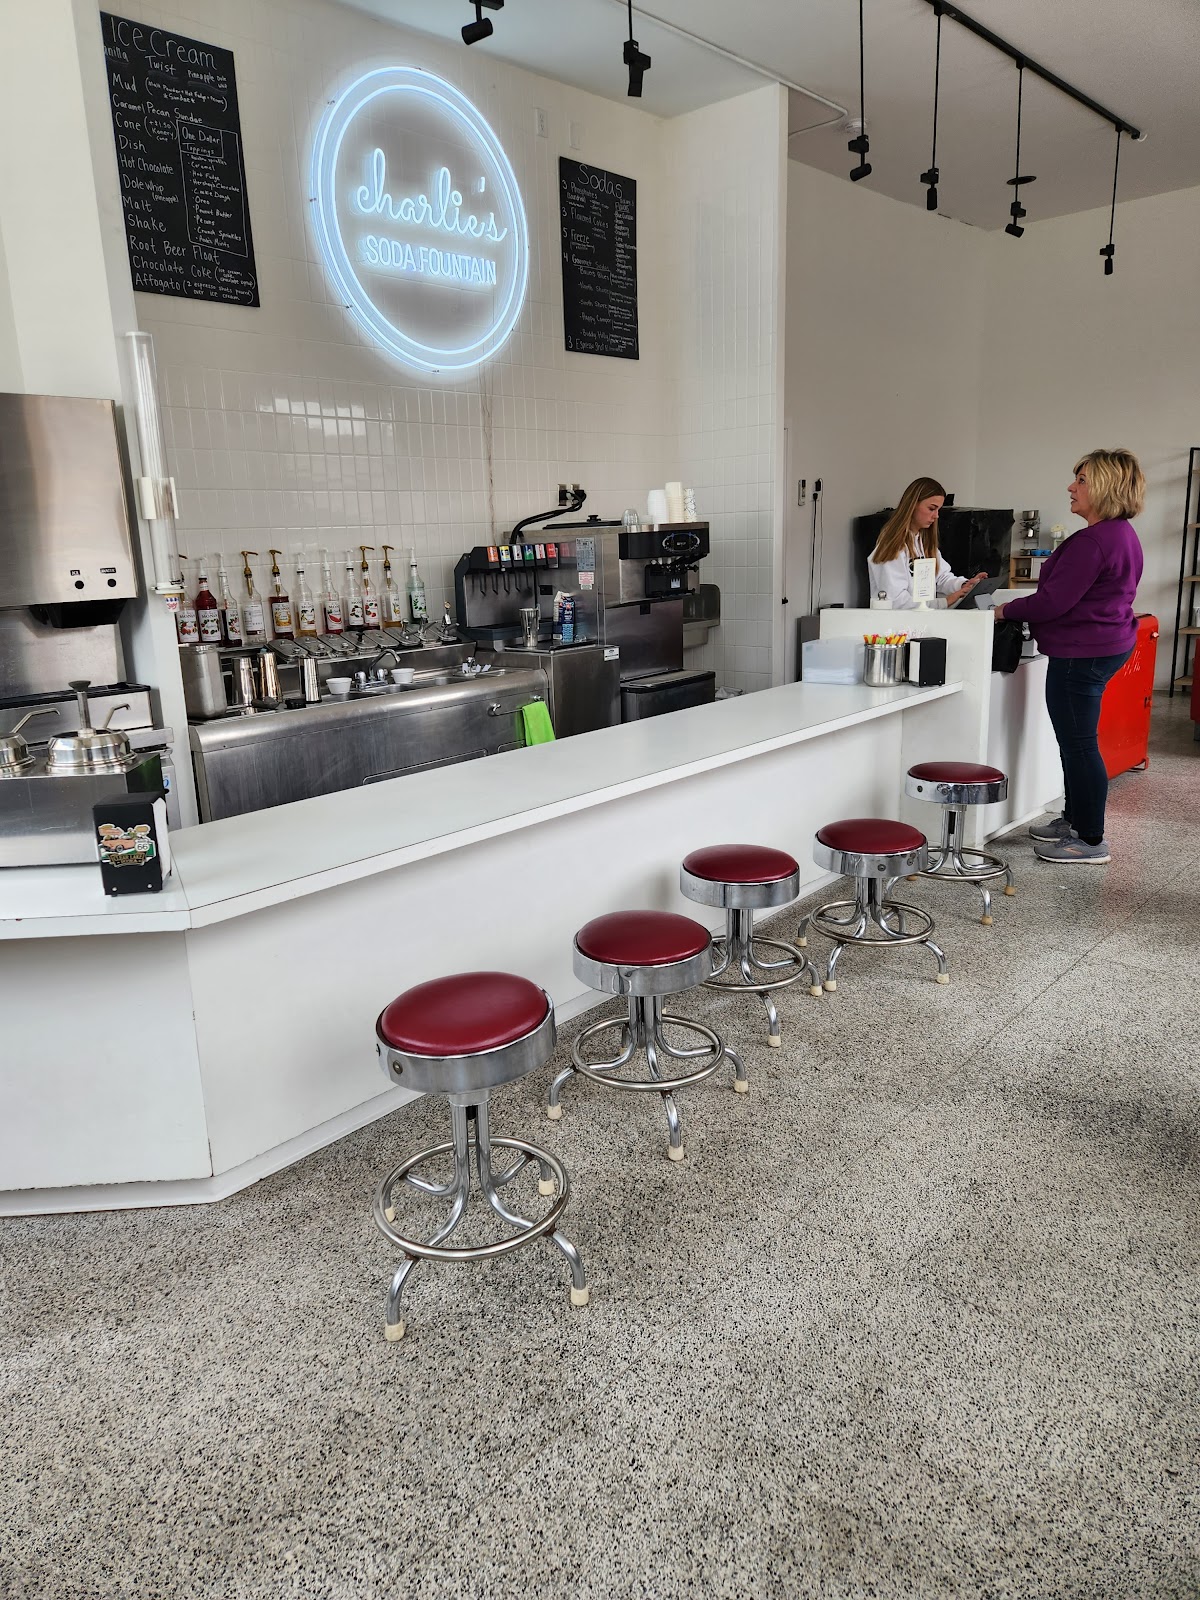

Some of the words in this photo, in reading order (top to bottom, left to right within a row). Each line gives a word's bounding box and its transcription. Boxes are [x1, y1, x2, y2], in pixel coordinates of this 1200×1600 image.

[104, 46, 129, 62] anilla
[150, 30, 217, 70] Cream
[145, 55, 176, 75] Twist
[113, 73, 137, 93] Mud
[113, 93, 145, 114] Caramel
[147, 101, 170, 118] Pecan
[174, 107, 203, 124] Sundae
[116, 112, 141, 131] Cone
[119, 134, 147, 154] Dish
[182, 127, 196, 141] One
[199, 130, 220, 144] Dollar
[182, 143, 214, 158] Toppings
[120, 152, 135, 169] Hot
[137, 157, 174, 175] Chocolate
[123, 174, 144, 189] Dole
[577, 163, 623, 199] Sodas
[122, 195, 152, 213] Malt
[128, 213, 166, 233] Shake
[571, 229, 590, 244] Freeze
[130, 235, 157, 255] Root
[164, 241, 186, 257] Beer
[193, 245, 220, 266] Float
[365, 235, 417, 272] SODA
[419, 247, 497, 286] FOUNTAIN
[132, 255, 184, 275] Chocolate
[191, 264, 212, 280] Coke
[135, 272, 181, 293] Affogato
[137, 843, 149, 851] 66
